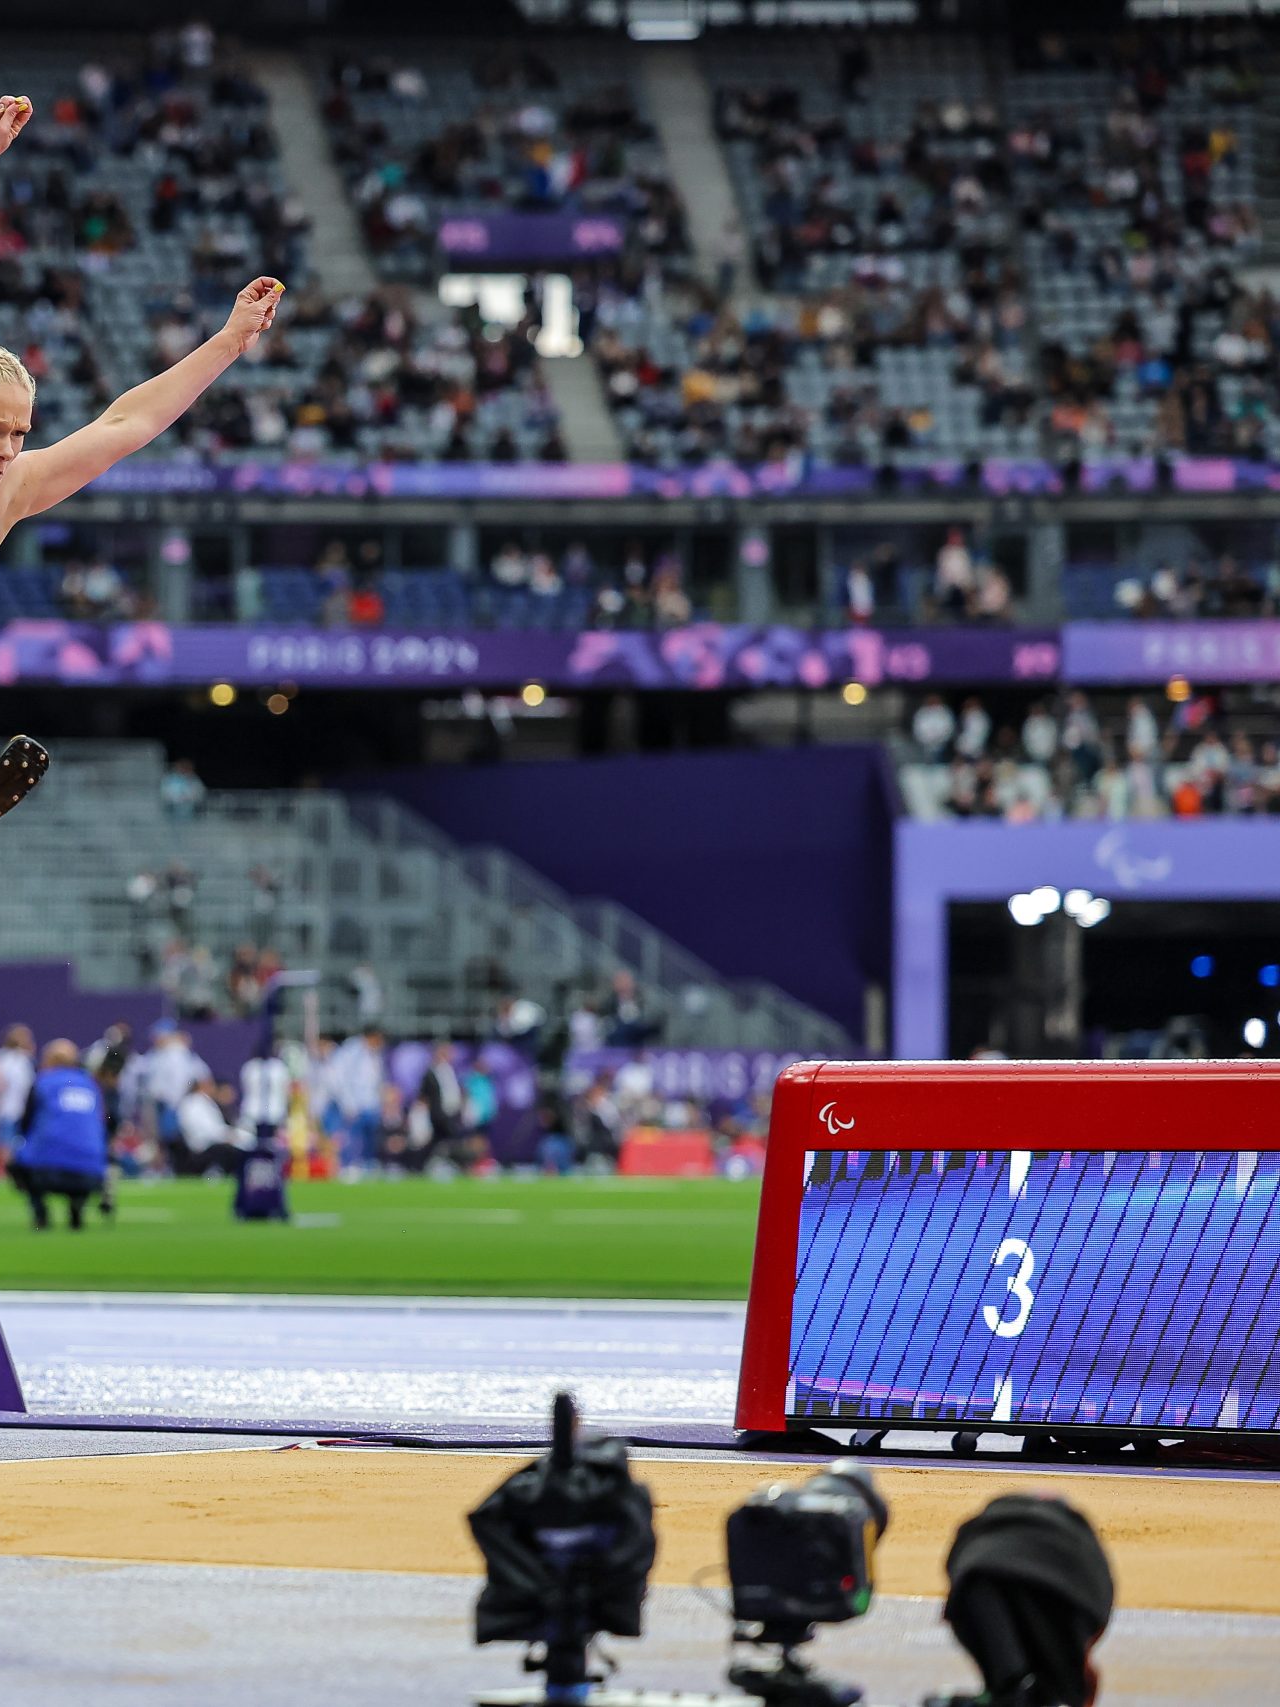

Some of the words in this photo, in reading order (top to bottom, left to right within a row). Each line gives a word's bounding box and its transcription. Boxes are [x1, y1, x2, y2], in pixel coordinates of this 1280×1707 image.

[249, 635, 367, 674] PARIS
[371, 635, 479, 676] 2024
[983, 1238, 1034, 1338] 3
